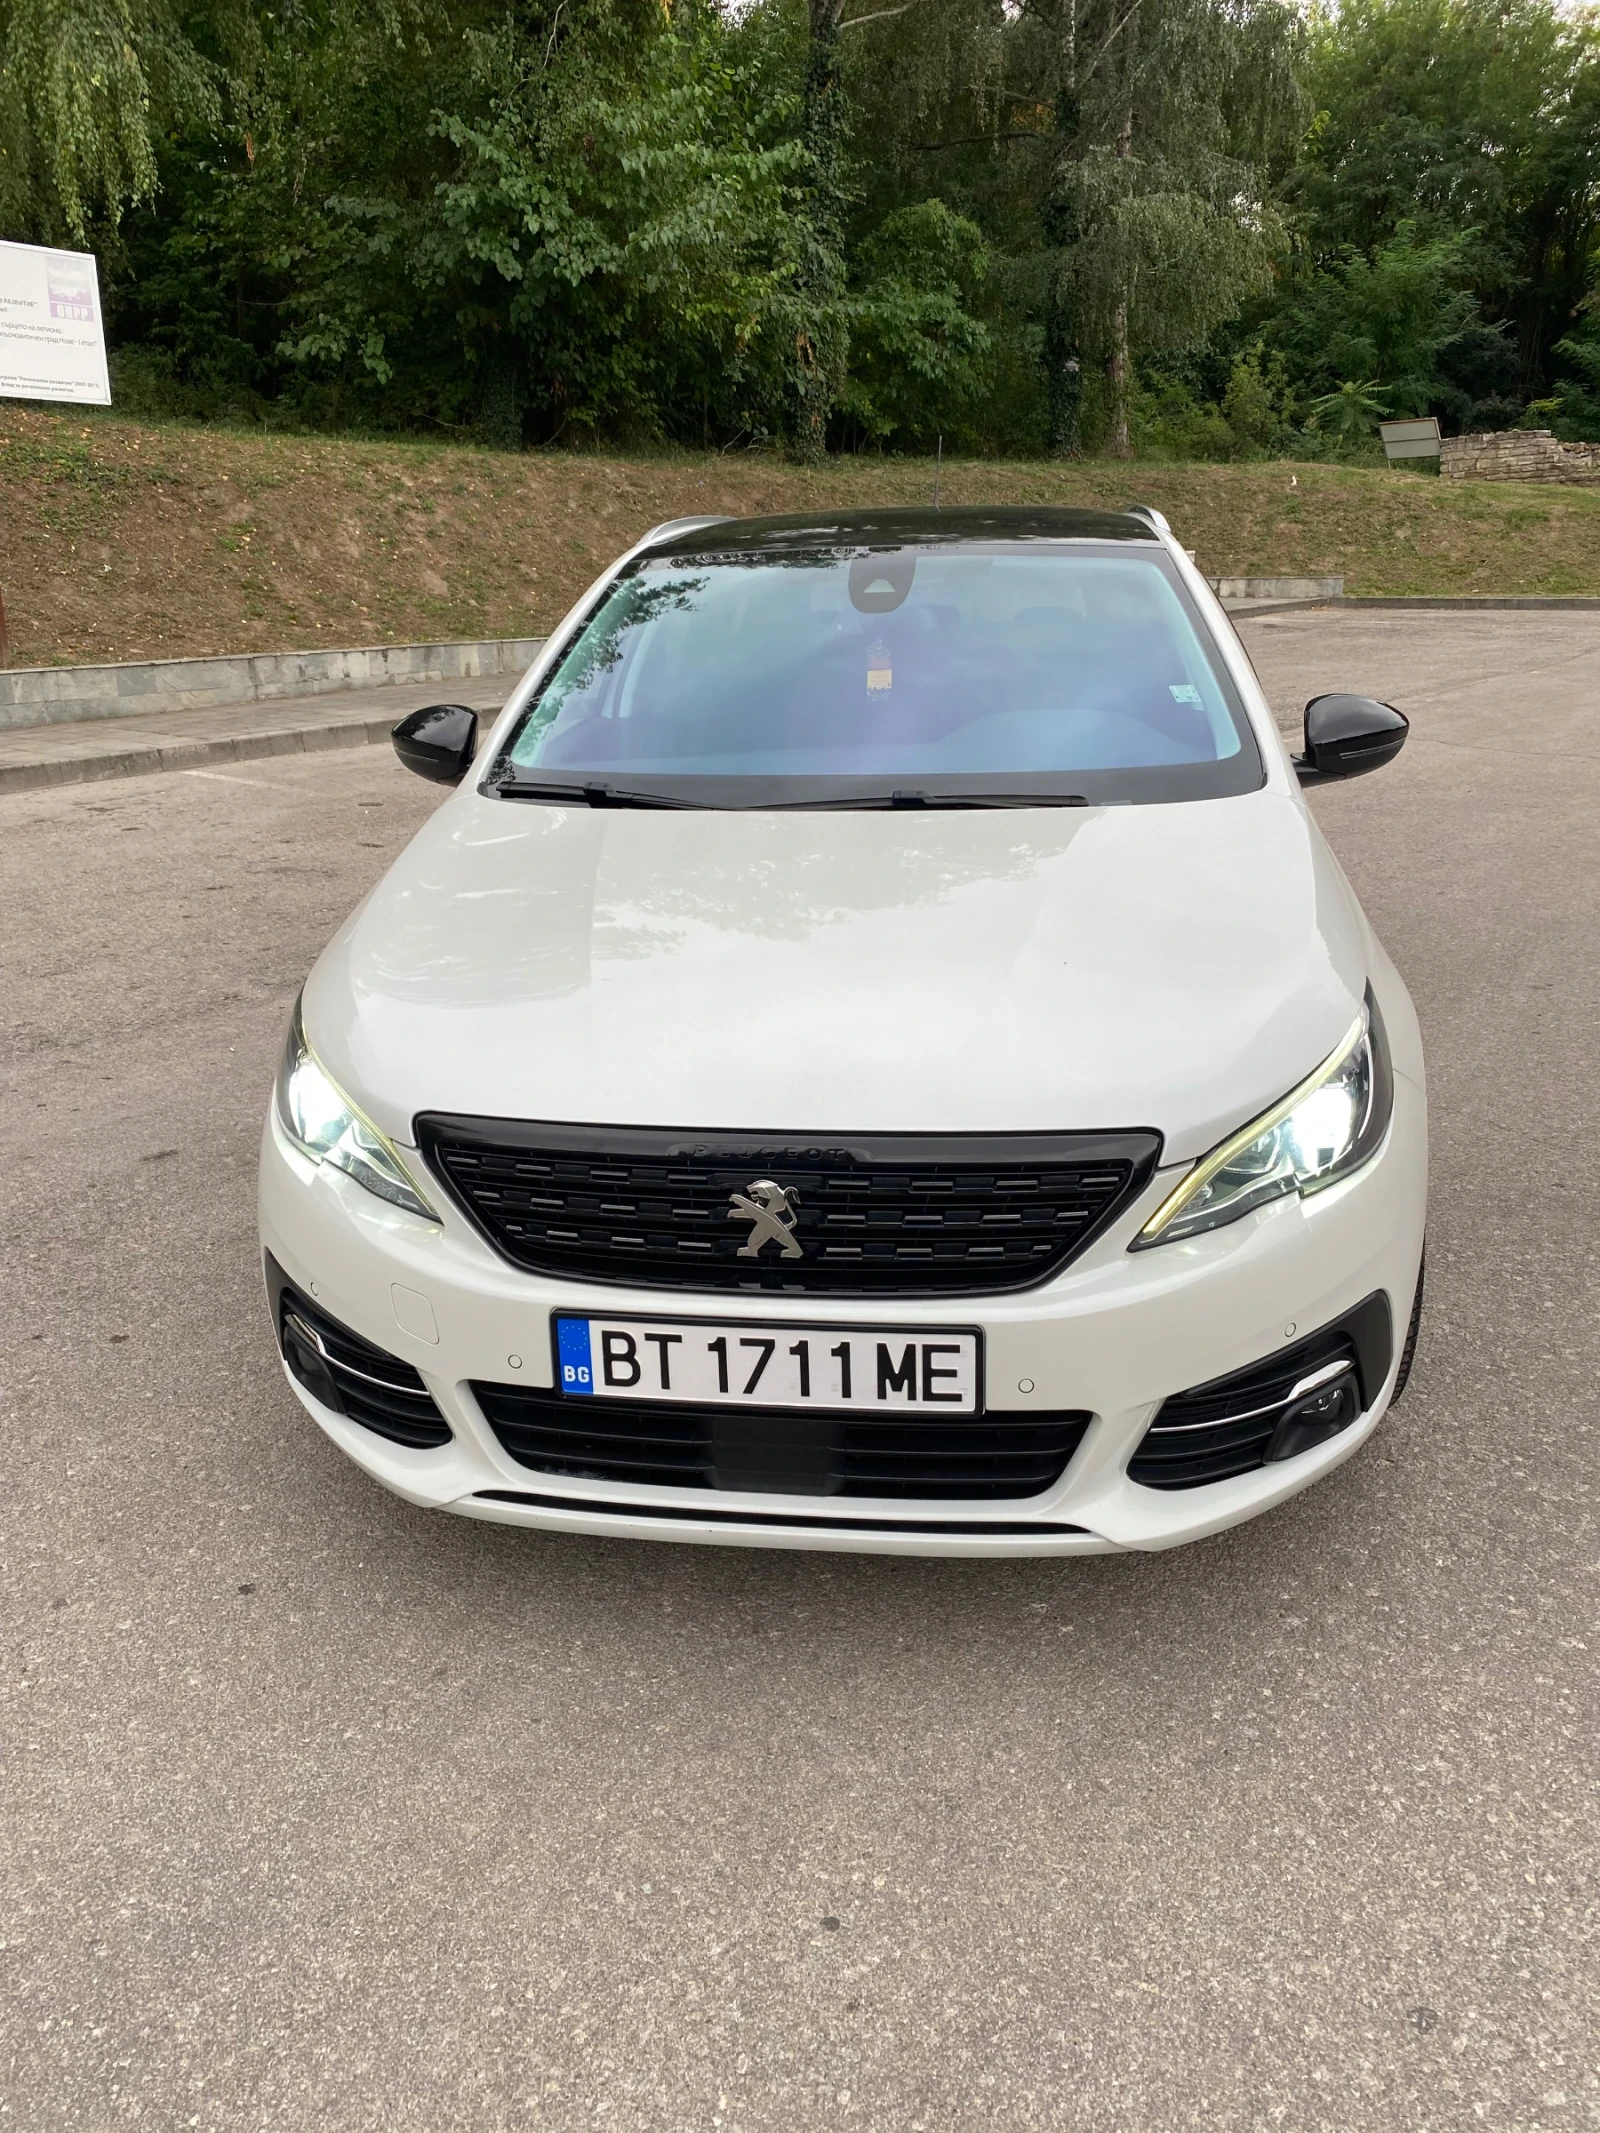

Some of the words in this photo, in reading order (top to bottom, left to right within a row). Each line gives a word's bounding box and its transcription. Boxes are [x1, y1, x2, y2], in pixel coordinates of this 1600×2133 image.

[1, 322, 27, 331] сърцето
[693, 1144, 845, 1161] PEUGEOT
[563, 1365, 590, 1383] BG
[601, 1330, 683, 1390] BT
[707, 1336, 852, 1398] 1711
[877, 1342, 963, 1402] ME
